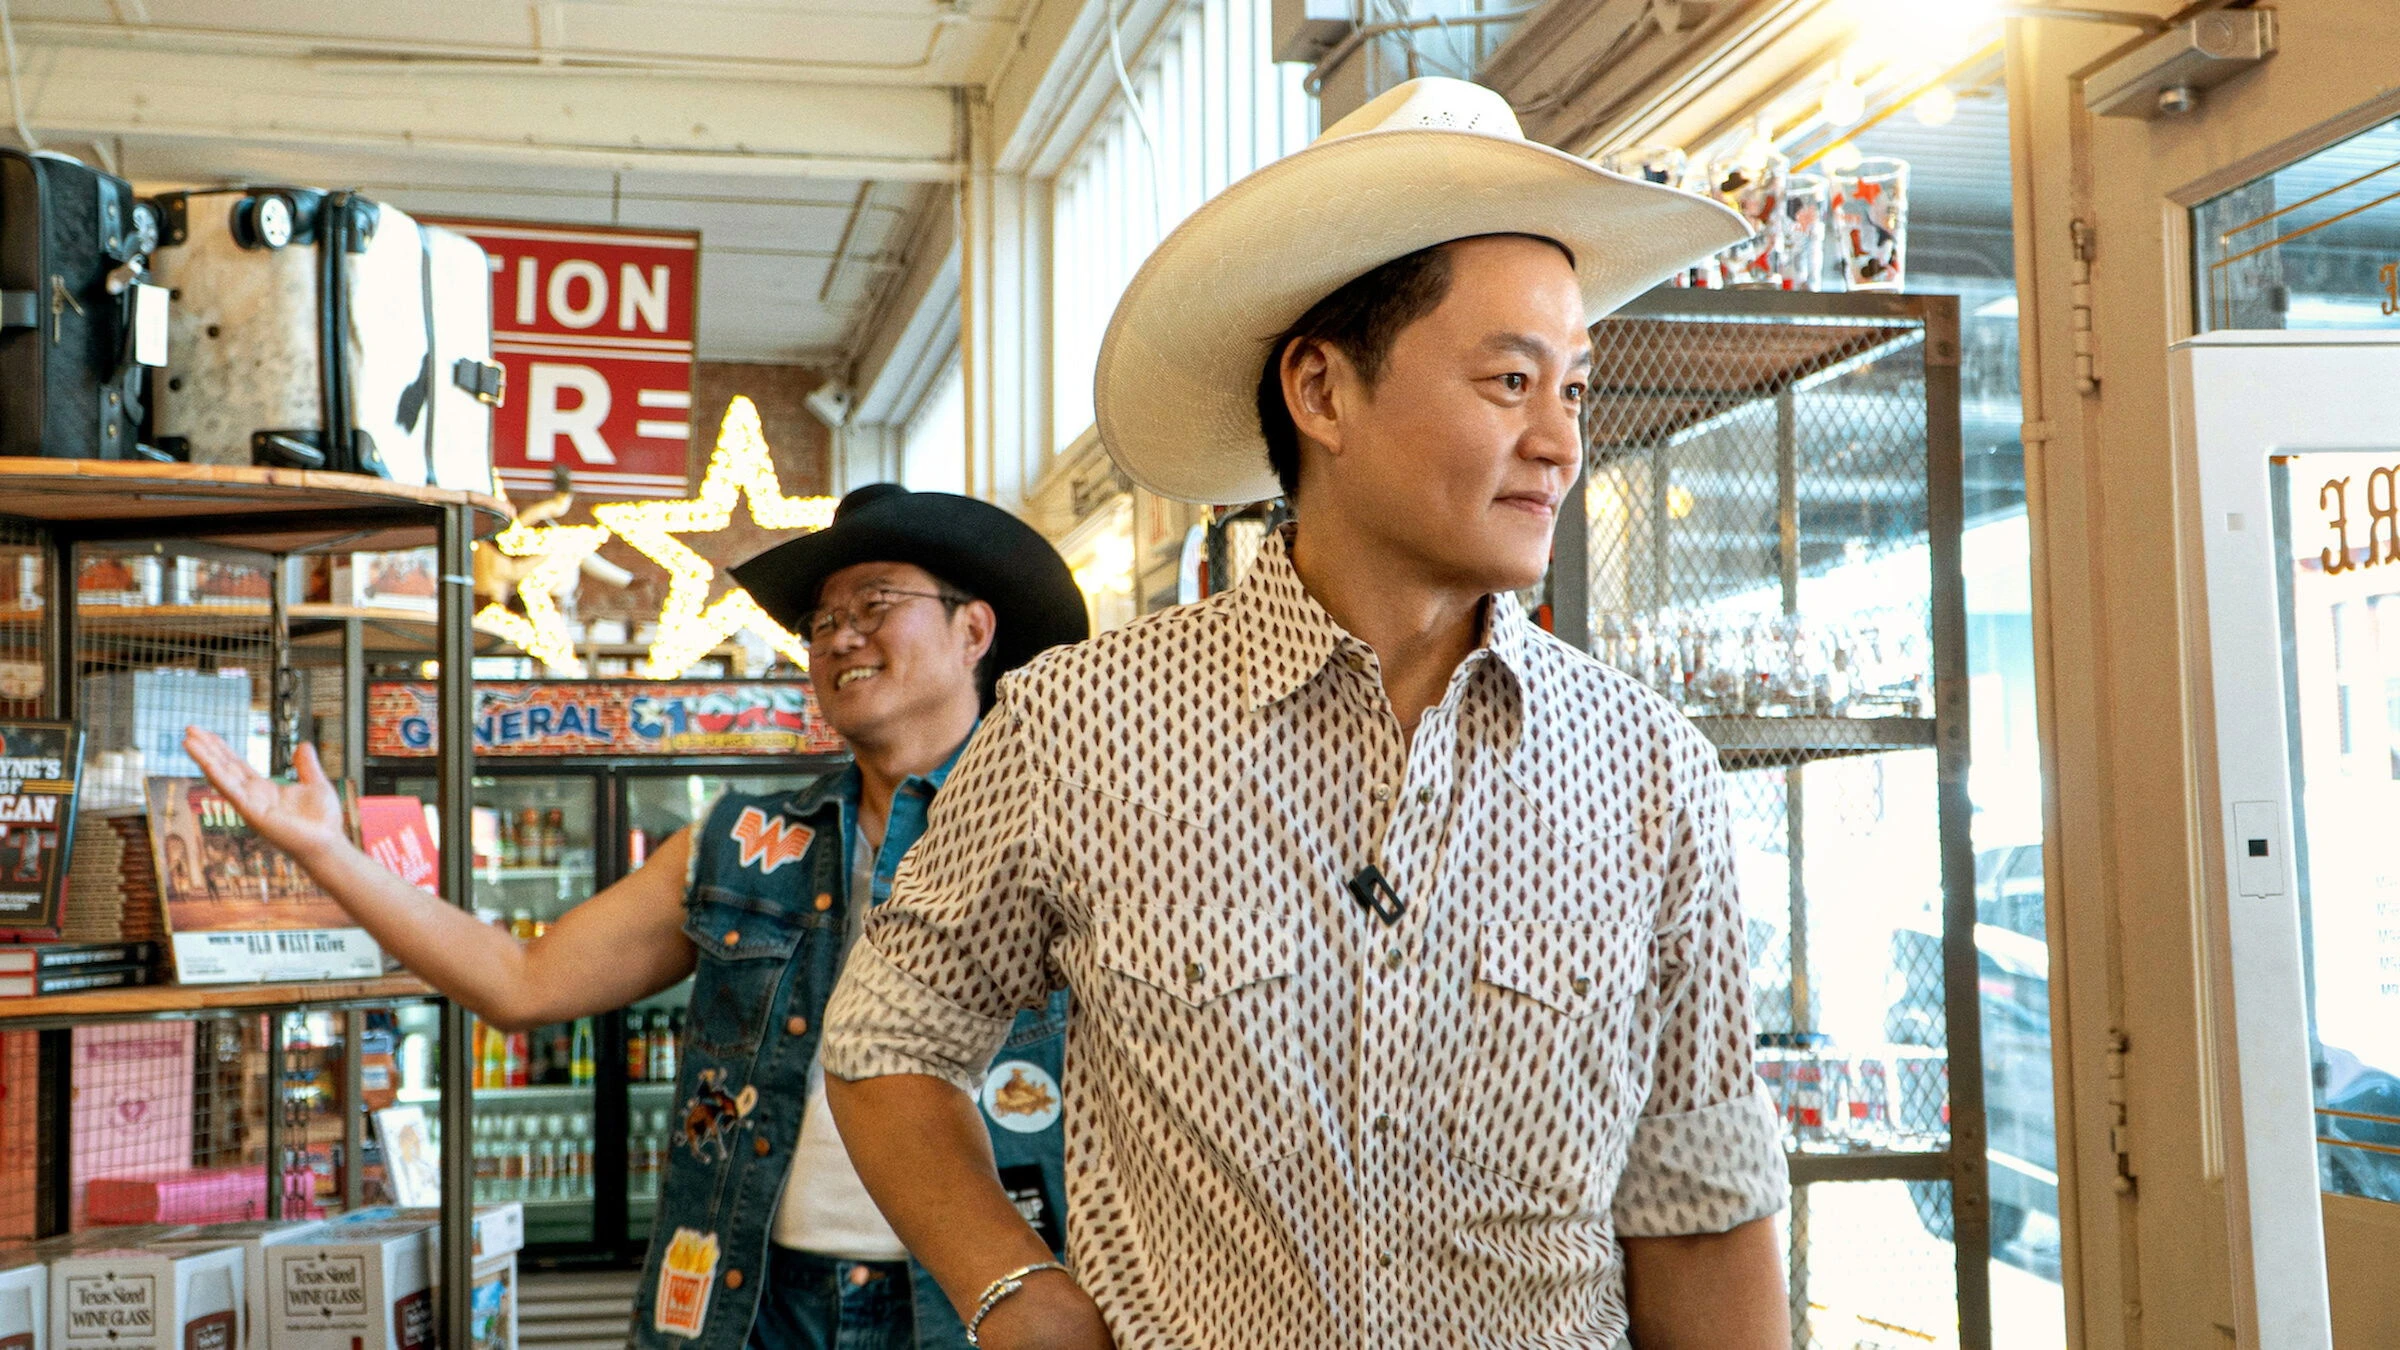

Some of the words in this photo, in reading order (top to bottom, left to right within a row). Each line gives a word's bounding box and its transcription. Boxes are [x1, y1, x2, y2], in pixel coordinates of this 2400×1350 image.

[489, 254, 670, 333] ION
[401, 705, 609, 749] GNERAL
[733, 809, 813, 870] W
[294, 1267, 325, 1284] Texas
[78, 1287, 112, 1306] Texas
[288, 1289, 322, 1305] WINE
[324, 1288, 362, 1304] GLASS
[71, 1310, 108, 1327] WINE
[110, 1308, 152, 1326] GLASS
